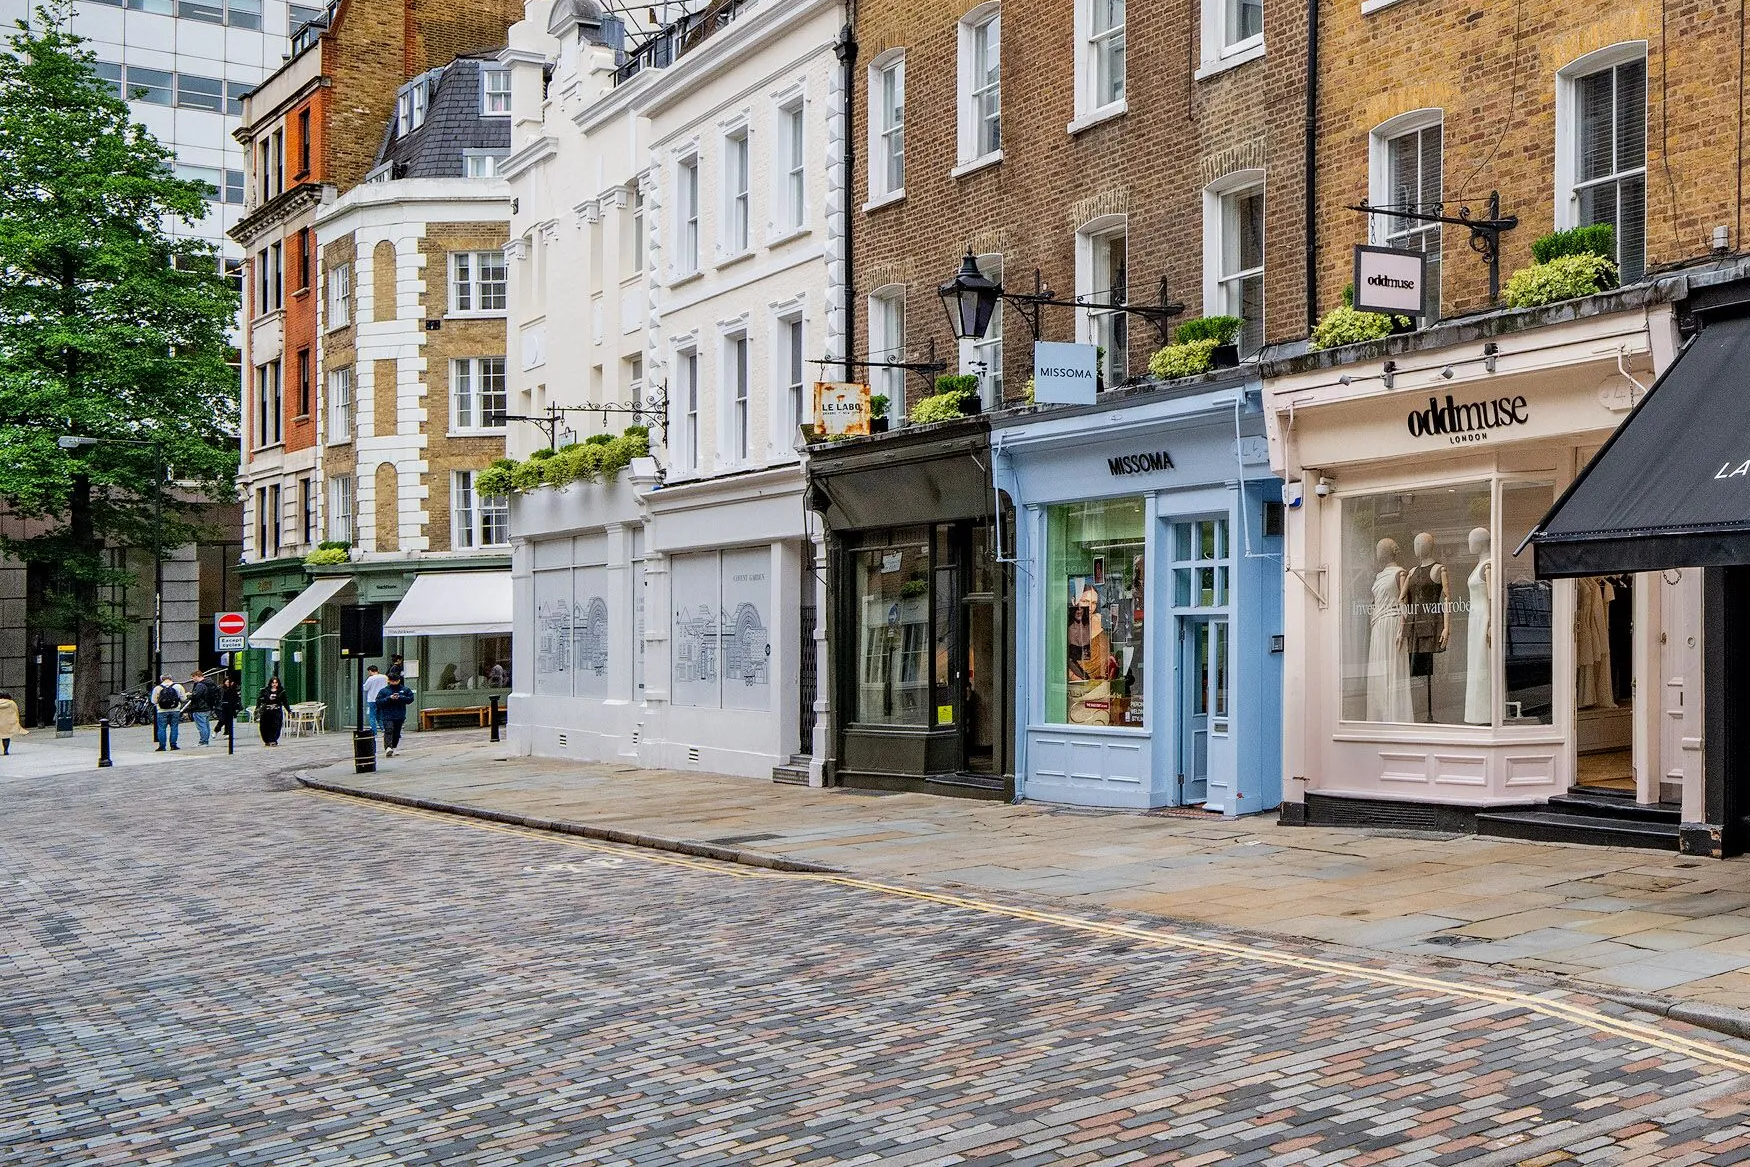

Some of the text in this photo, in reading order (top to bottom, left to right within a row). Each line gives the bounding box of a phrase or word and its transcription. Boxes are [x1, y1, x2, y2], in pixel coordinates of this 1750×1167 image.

[1367, 274, 1415, 290] oddmuse
[1040, 367, 1093, 379] MISSOMA
[822, 403, 861, 411] LE LABO
[1407, 395, 1529, 437] oddmuse
[1450, 432, 1488, 445] LONDON
[1107, 451, 1175, 476] MISSOMA
[1422, 595, 1472, 614] wardrobe
